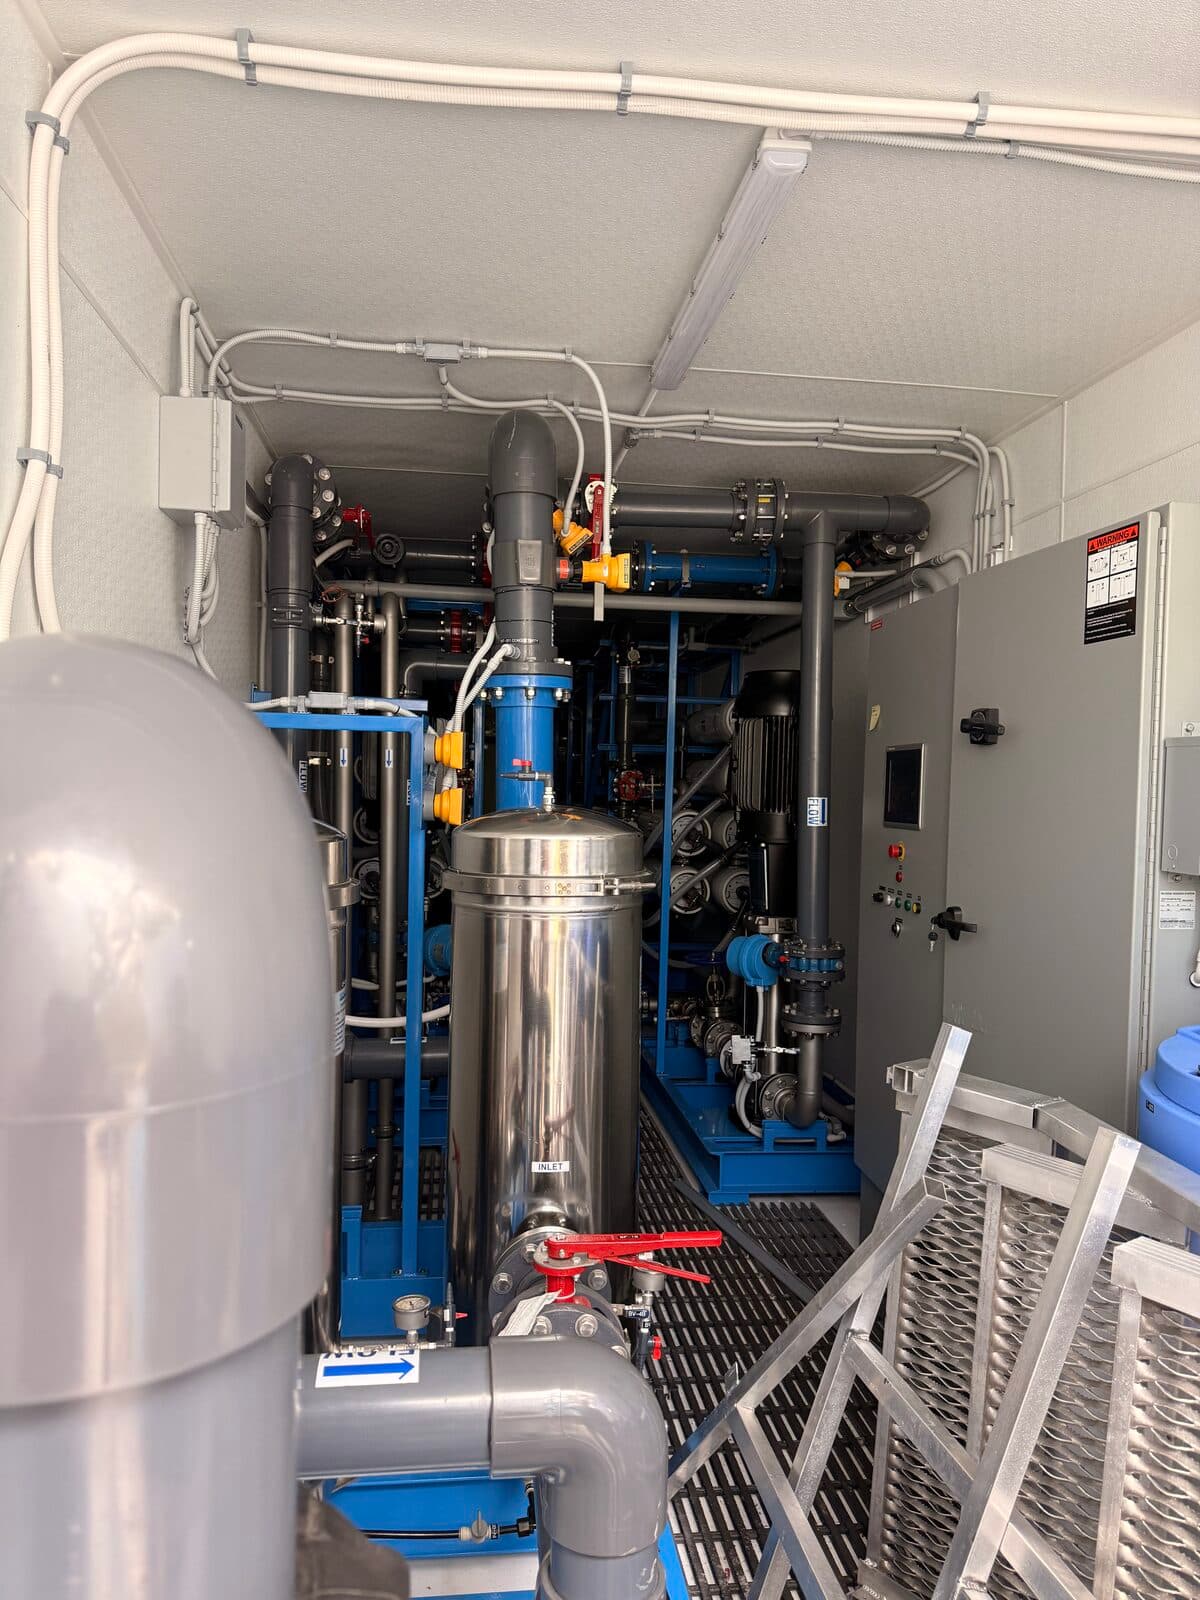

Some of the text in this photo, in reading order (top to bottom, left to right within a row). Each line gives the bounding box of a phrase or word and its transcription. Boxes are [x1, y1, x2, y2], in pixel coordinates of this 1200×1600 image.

[1096, 530, 1129, 547] WARNING
[808, 798, 819, 825] FLOW
[538, 1162, 563, 1171] INLET
